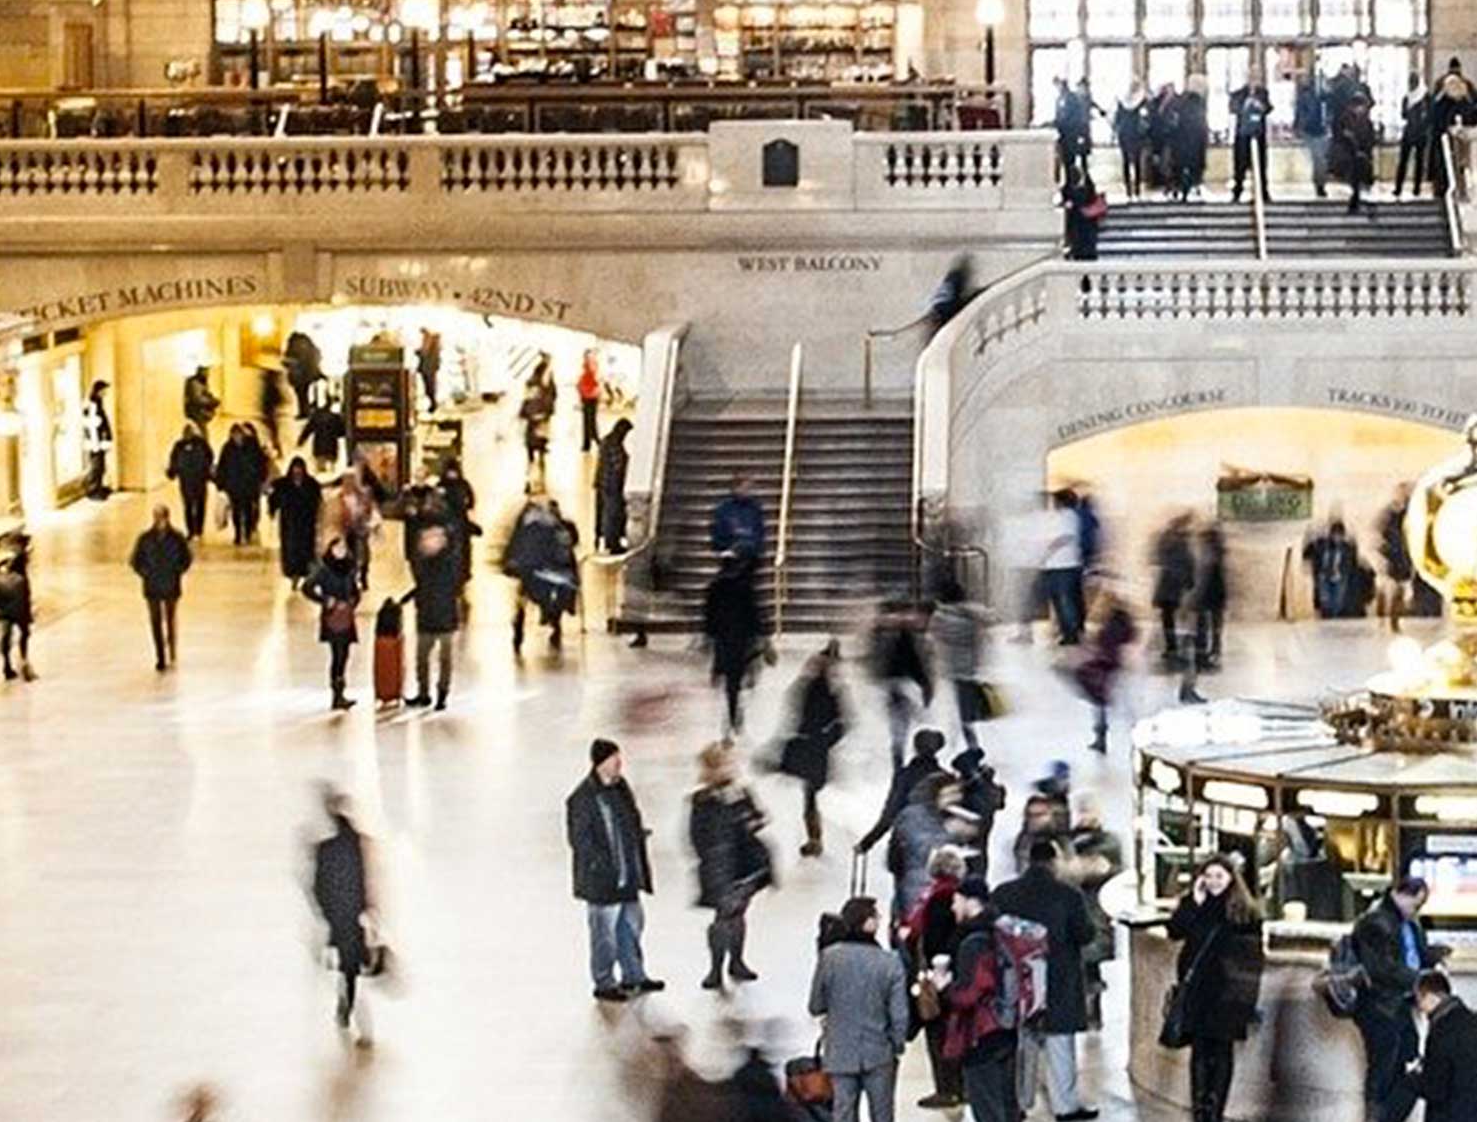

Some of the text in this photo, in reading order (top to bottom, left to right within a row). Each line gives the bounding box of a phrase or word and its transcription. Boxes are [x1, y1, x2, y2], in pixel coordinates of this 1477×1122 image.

[737, 254, 883, 272] WEST BALCONY
[118, 274, 257, 309] MACHINES
[345, 276, 573, 321] SUBWAY 42ND ST
[1057, 389, 1225, 439] DINING CONCOURSE
[1328, 387, 1391, 408] TRACKS
